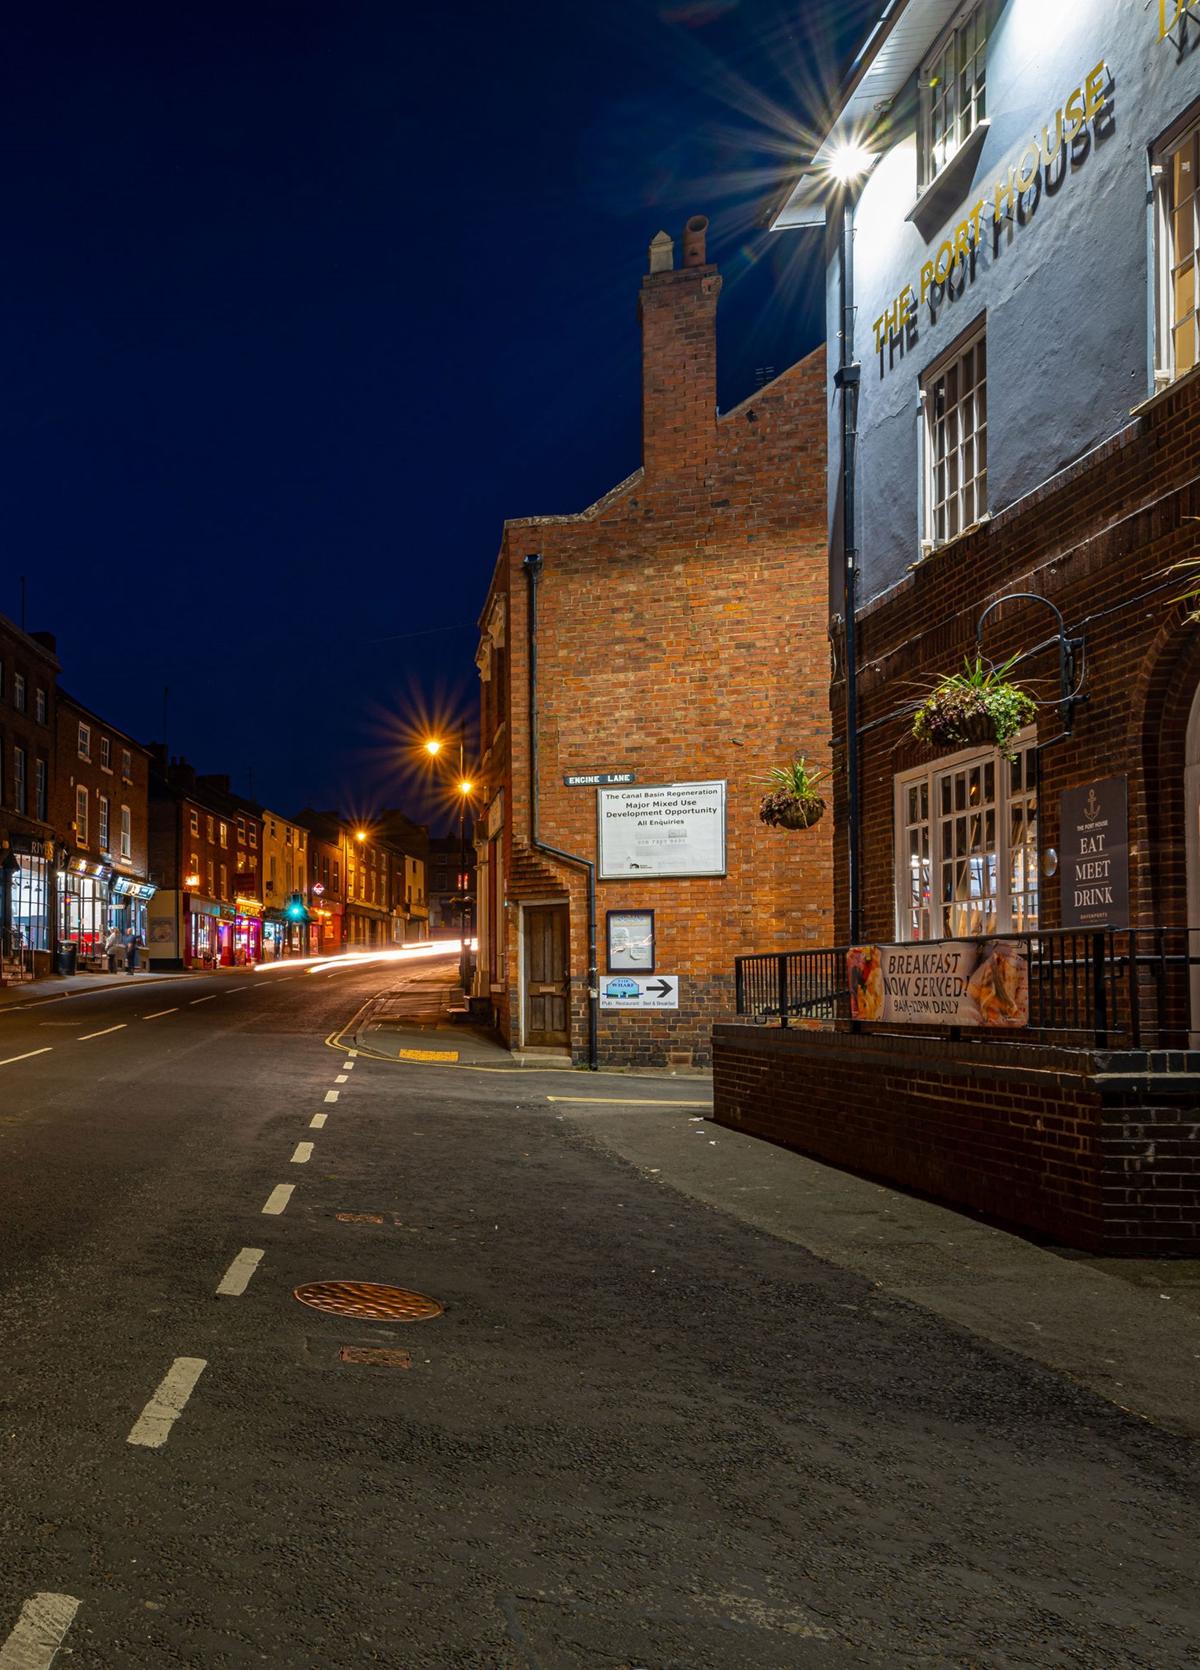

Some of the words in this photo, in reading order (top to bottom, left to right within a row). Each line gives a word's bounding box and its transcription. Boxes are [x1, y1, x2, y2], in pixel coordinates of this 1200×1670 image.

[873, 284, 912, 353] THE
[920, 200, 986, 304] PORT
[994, 59, 1106, 223] HOUSE
[569, 776, 600, 784] ENGINE
[607, 774, 630, 782] LANE
[667, 789, 718, 797] Regeneration
[606, 810, 663, 818] Development
[665, 807, 718, 815] Opportunity
[1080, 834, 1105, 855] EAT
[1075, 860, 1111, 881] MEET
[1074, 887, 1113, 907] DRINK
[888, 953, 961, 974] BREAKFAST
[884, 979, 910, 996] NOW
[913, 976, 970, 998] SERVED!
[932, 1000, 959, 1014] DAILY
